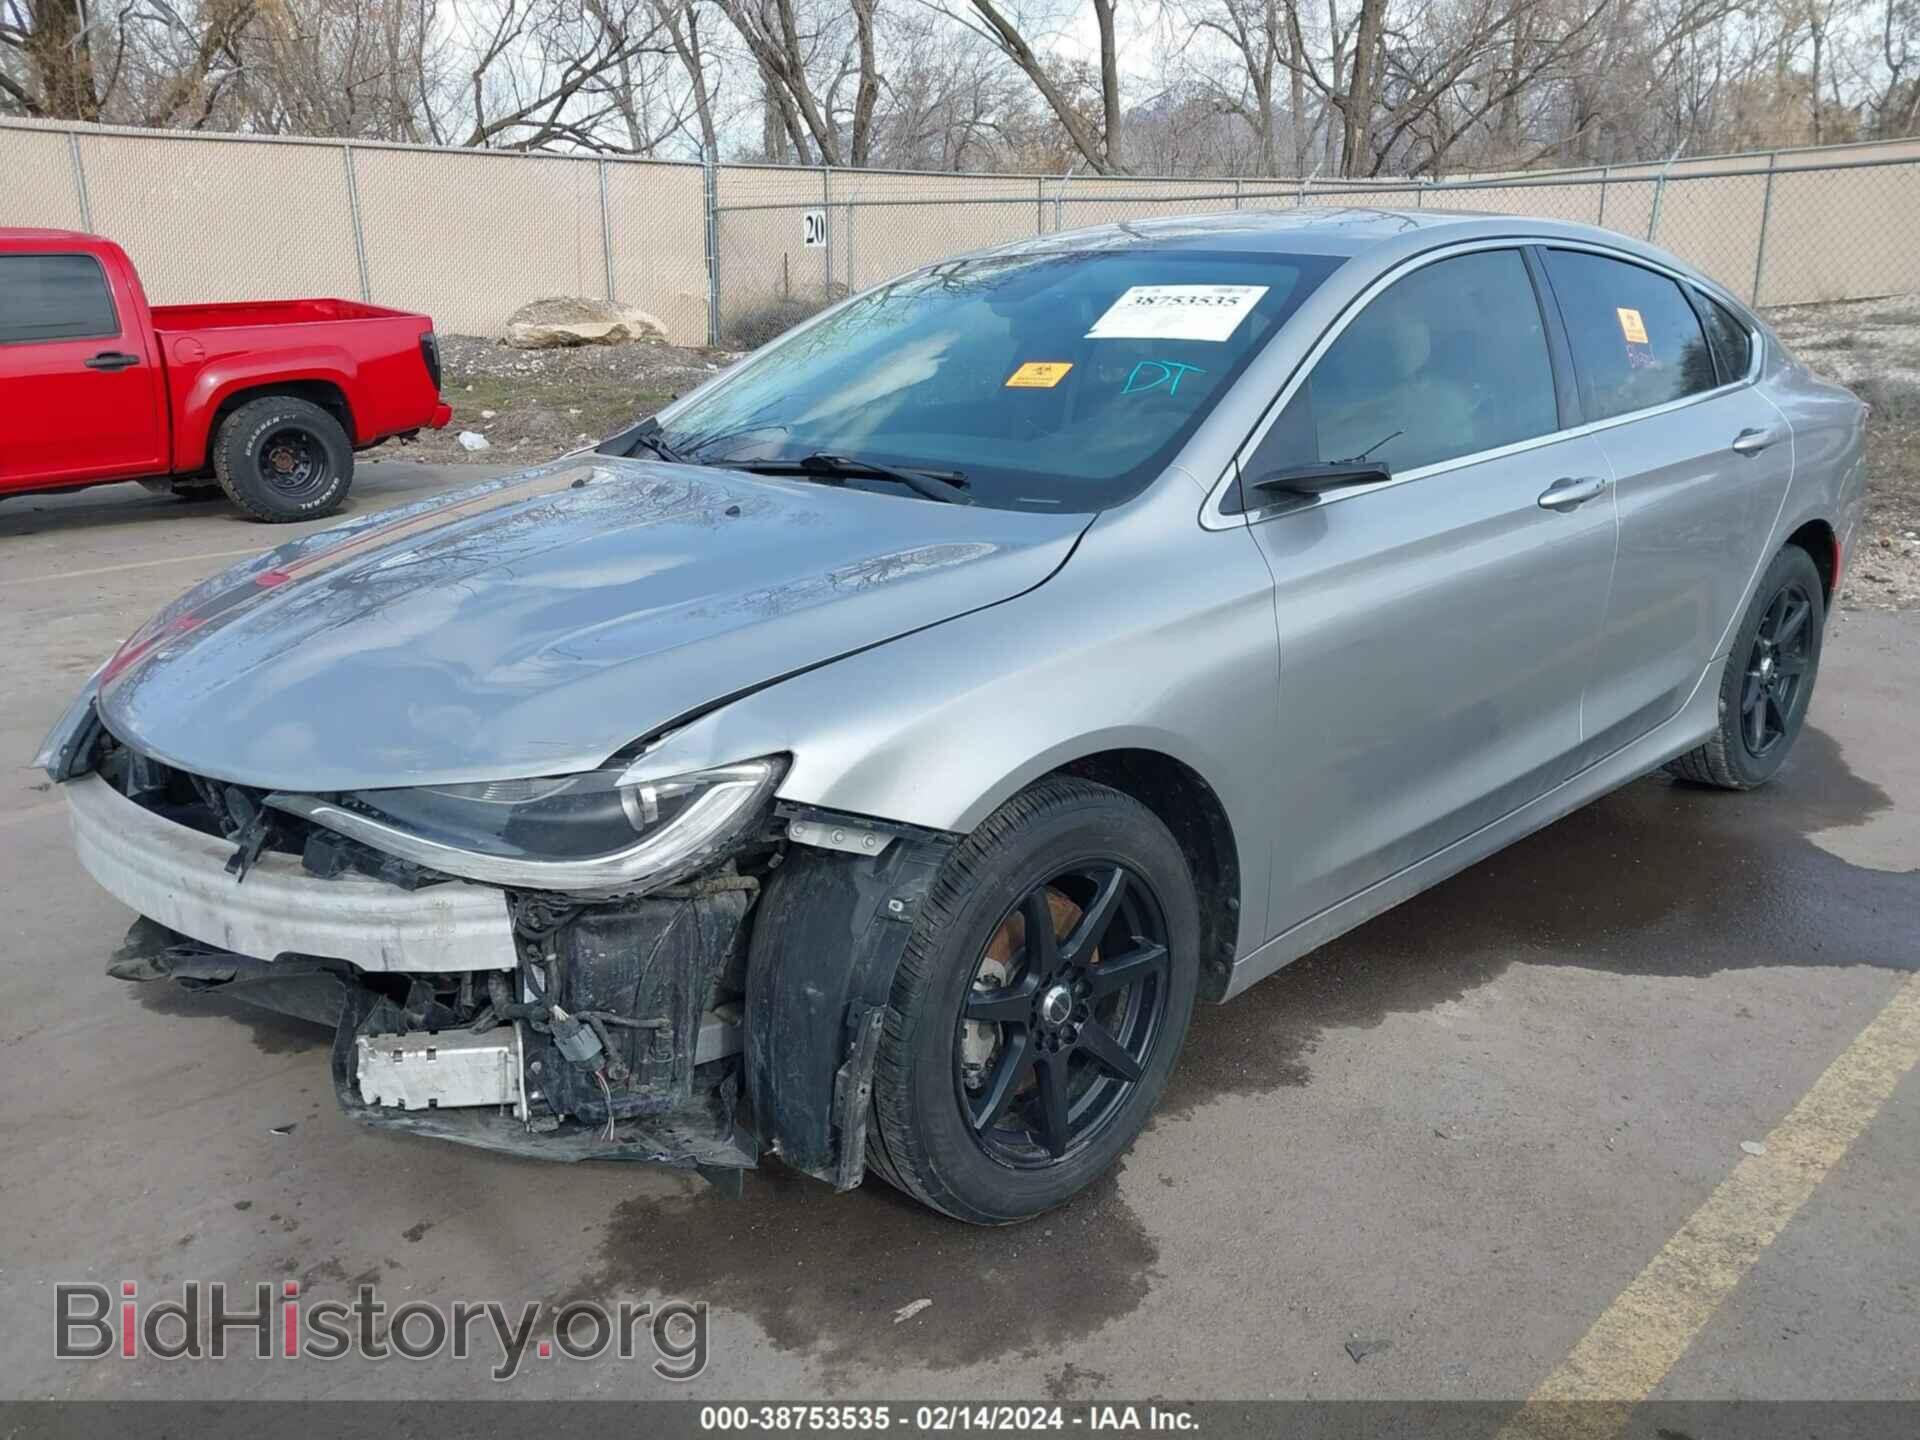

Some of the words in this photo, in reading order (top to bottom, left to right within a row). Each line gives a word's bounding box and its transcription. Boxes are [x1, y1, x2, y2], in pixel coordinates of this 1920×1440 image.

[805, 214, 825, 243] 20
[1127, 295, 1241, 307] 38753535
[1120, 360, 1208, 396] DT
